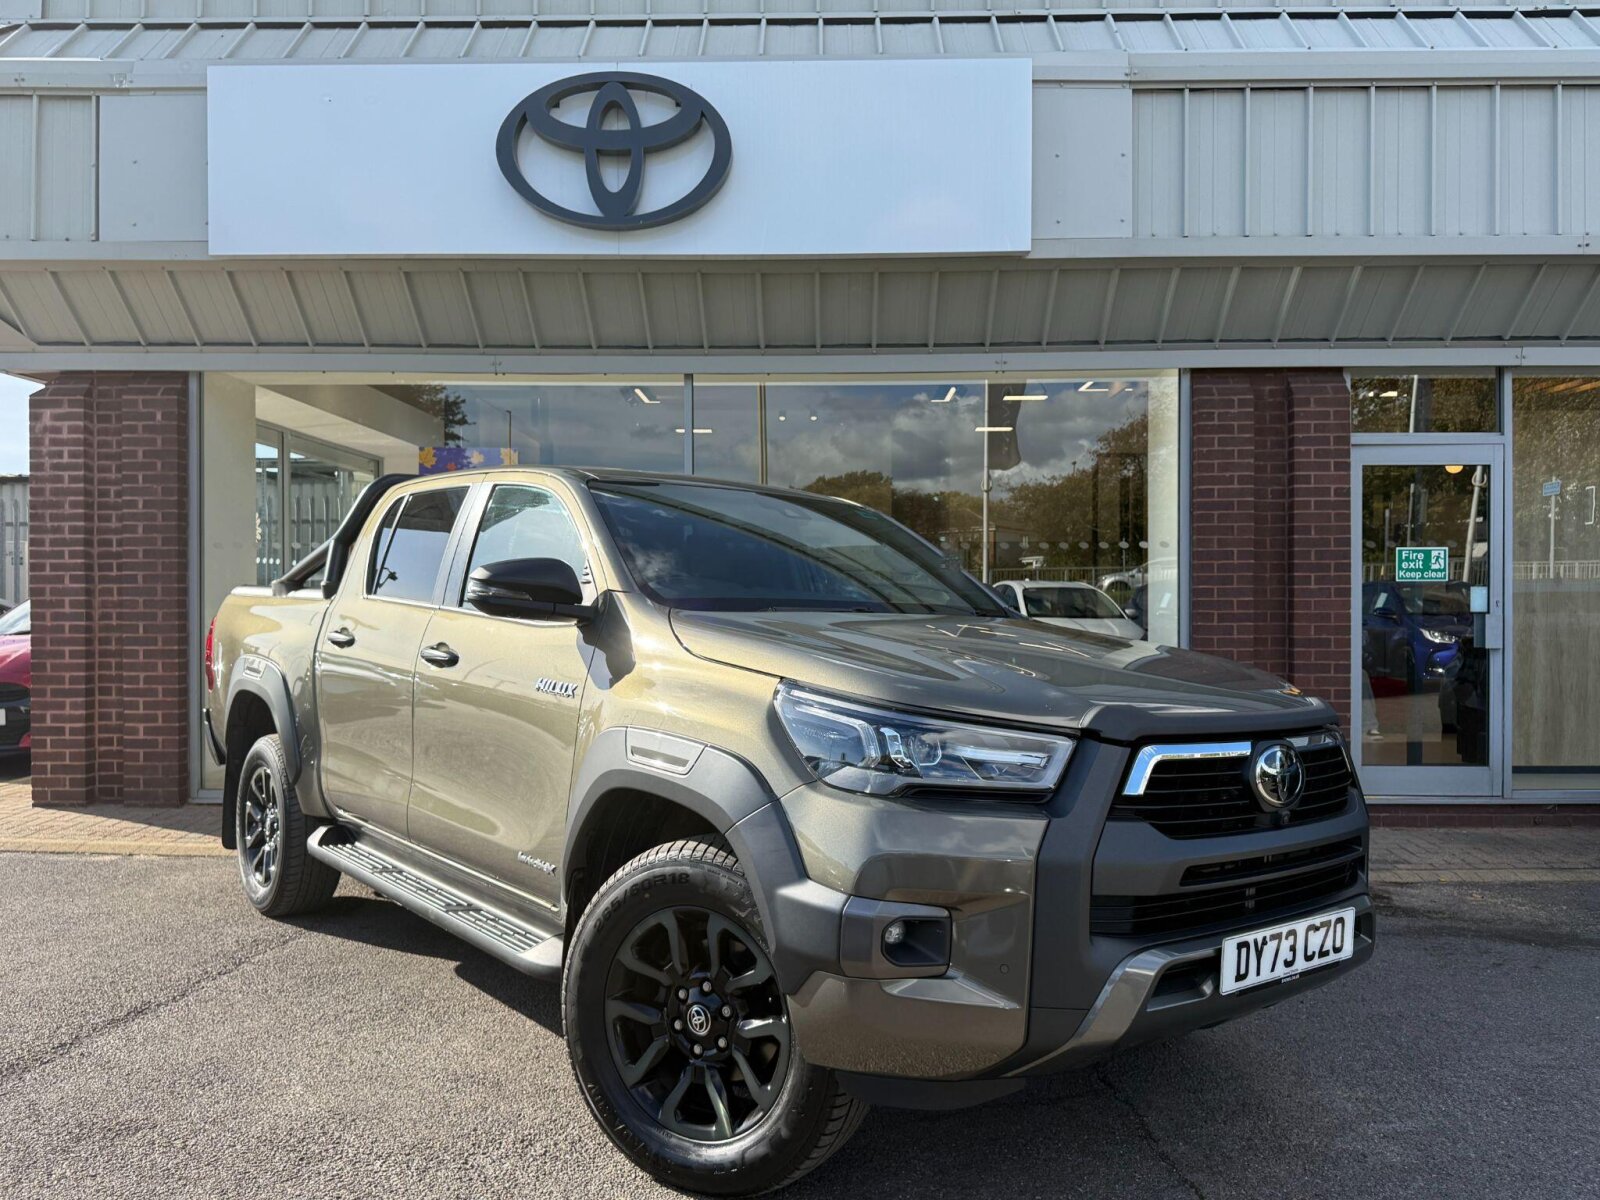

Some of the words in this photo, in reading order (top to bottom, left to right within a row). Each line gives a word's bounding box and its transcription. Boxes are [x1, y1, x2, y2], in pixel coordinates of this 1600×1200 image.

[1402, 550, 1424, 560] Fire
[1402, 560, 1423, 569] exit
[1399, 570, 1421, 579] Keep
[1423, 570, 1445, 578] clear
[535, 677, 579, 698] HILUX
[1235, 929, 1297, 982] DY73
[1304, 917, 1345, 962] CZO
